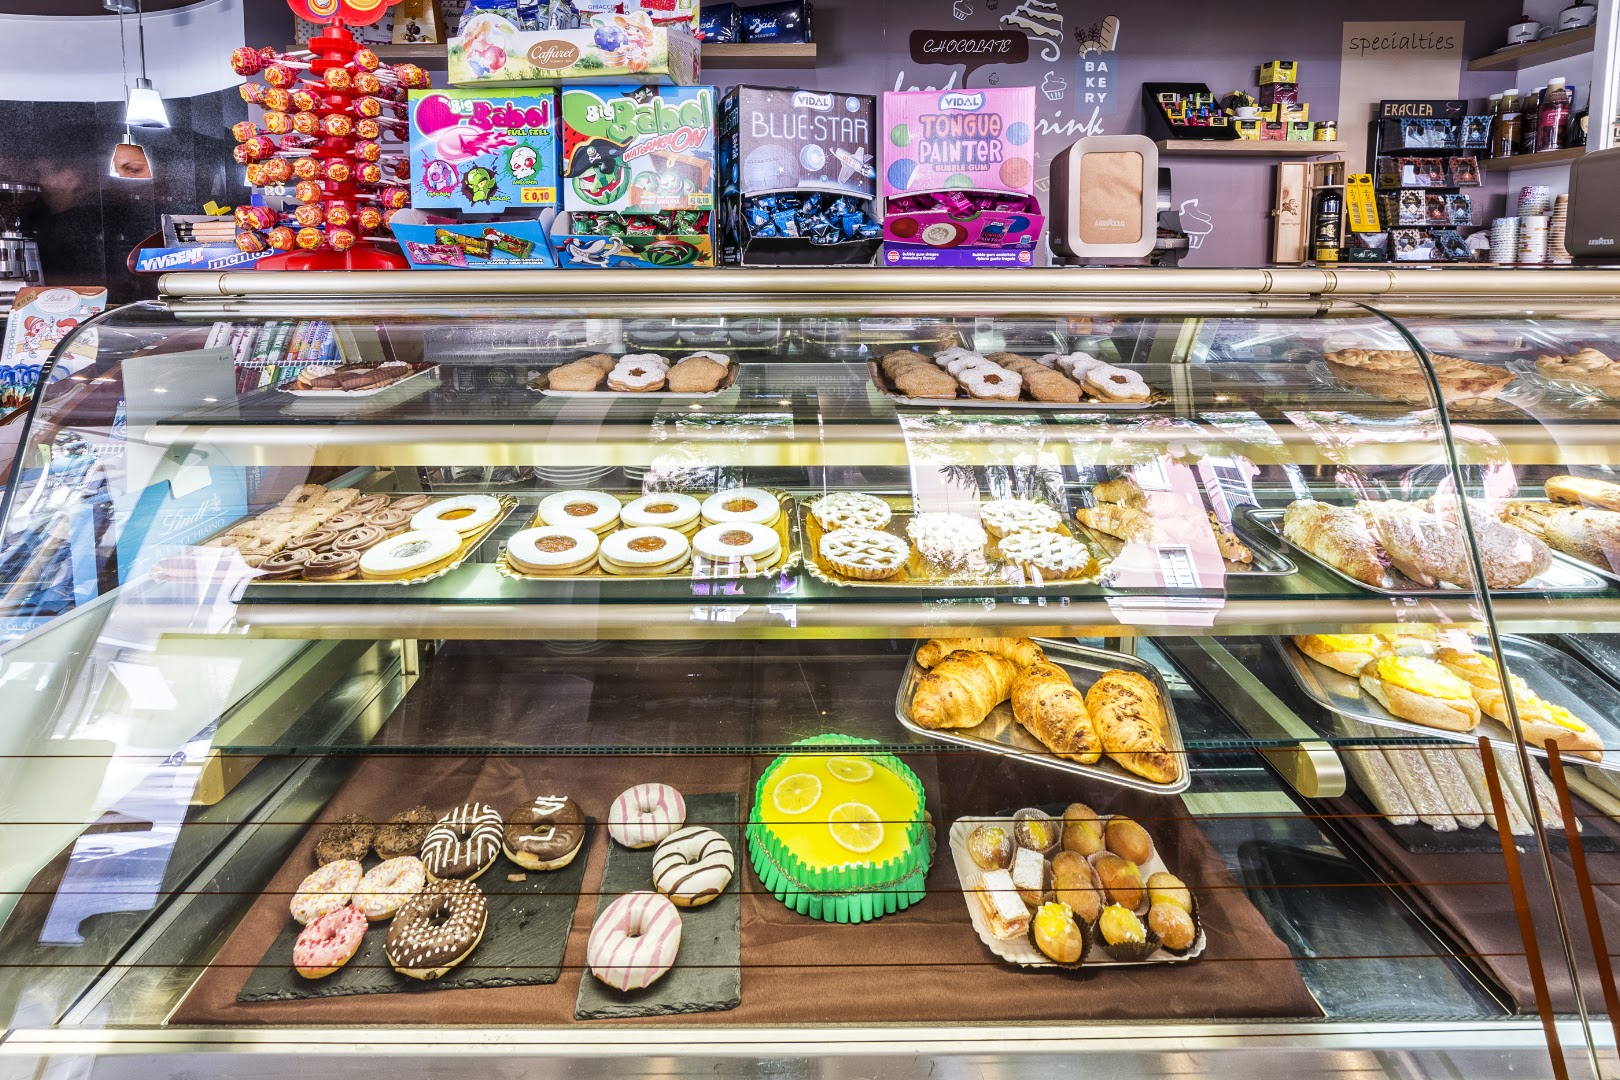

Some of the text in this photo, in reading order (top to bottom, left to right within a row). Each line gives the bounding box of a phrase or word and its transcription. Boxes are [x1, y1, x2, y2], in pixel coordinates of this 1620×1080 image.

[701, 19, 715, 29] aci
[748, 18, 777, 33] Baci
[923, 39, 1012, 53] CHOCOLATE
[1349, 32, 1455, 57] specialties
[531, 45, 575, 65] Caffarel
[451, 99, 474, 112] Big
[798, 96, 829, 107] VIDAL
[945, 97, 979, 107] VIDAL
[469, 101, 549, 130] Babol
[586, 104, 614, 122] Big
[607, 91, 711, 143] Babol
[1384, 104, 1433, 116] ERACLEA
[1035, 105, 1104, 136] rink
[935, 164, 989, 172] BUBBLE GUM
[524, 191, 550, 203] € 0,10
[1588, 237, 1615, 245] LAVAZZA
[6, 313, 19, 360] doppiolatte
[160, 500, 212, 537] Lindt
